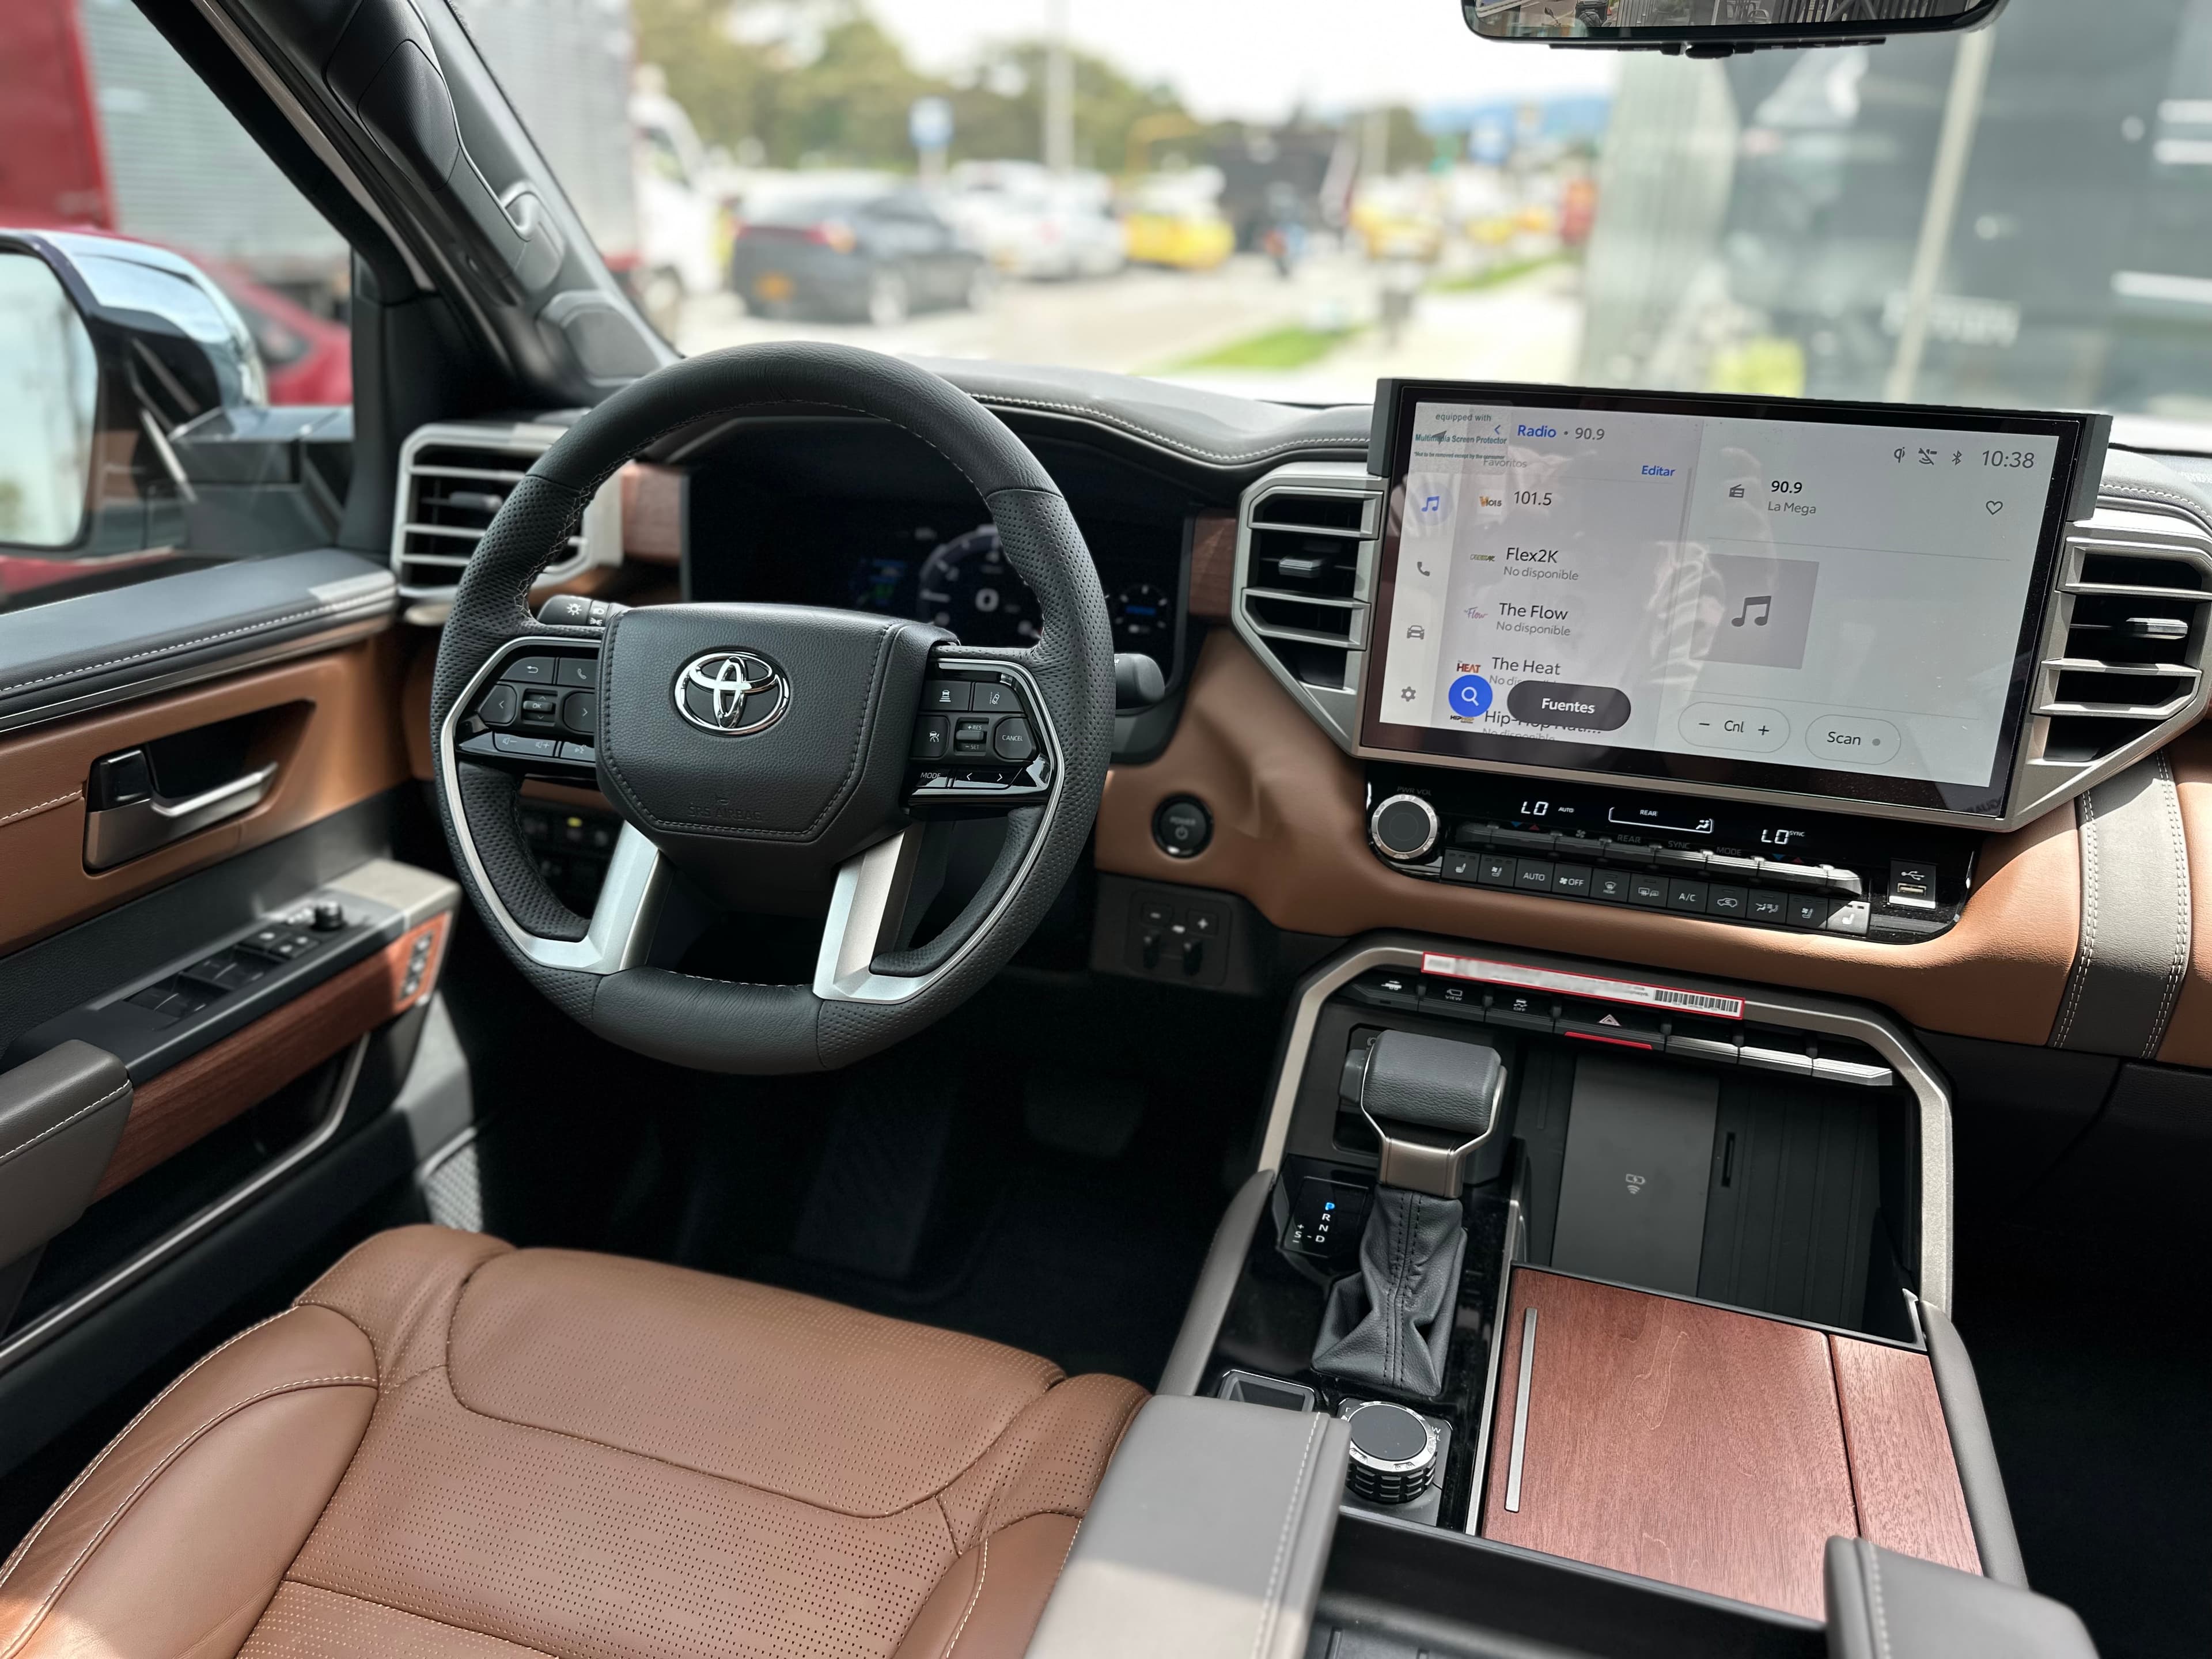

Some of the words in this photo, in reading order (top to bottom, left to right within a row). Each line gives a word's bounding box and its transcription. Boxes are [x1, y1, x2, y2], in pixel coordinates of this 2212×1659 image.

[1435, 414, 1472, 422] equipped
[1517, 425, 1556, 438] Radio
[1575, 427, 1605, 440] 90.9
[1476, 436, 1508, 444] Protector
[1483, 459, 1528, 468] Favoritos
[1982, 450, 2035, 469] 10:38
[1641, 465, 1675, 476] Editar
[1770, 480, 1803, 495] 90.9
[1513, 491, 1553, 506] 101.5
[1768, 502, 1781, 512] La
[1783, 502, 1817, 516] Mega
[1506, 547, 1559, 563] Flex2K
[1503, 566, 1520, 576] No
[1521, 567, 1579, 580] disponible
[1499, 603, 1527, 617] The
[1530, 605, 1569, 620] Flow
[1497, 621, 1512, 631] No
[1514, 623, 1571, 636] disponible
[1456, 663, 1481, 673] HEAT
[1492, 657, 1519, 671] The
[1522, 660, 1561, 675] Heat
[1489, 675, 1505, 685] No
[1541, 698, 1596, 714] Fuentes
[1724, 720, 1744, 733] Cnl
[1827, 732, 1861, 746] Scan
[1617, 834, 1641, 843] REAR
[1668, 840, 1691, 850] SYNC
[1716, 846, 1742, 856] MODE
[1523, 872, 1546, 881] AUTO
[1568, 878, 1584, 887] OFF
[1679, 892, 1696, 902] A/C
[1325, 1202, 1335, 1210] P
[1321, 1213, 1331, 1221] R
